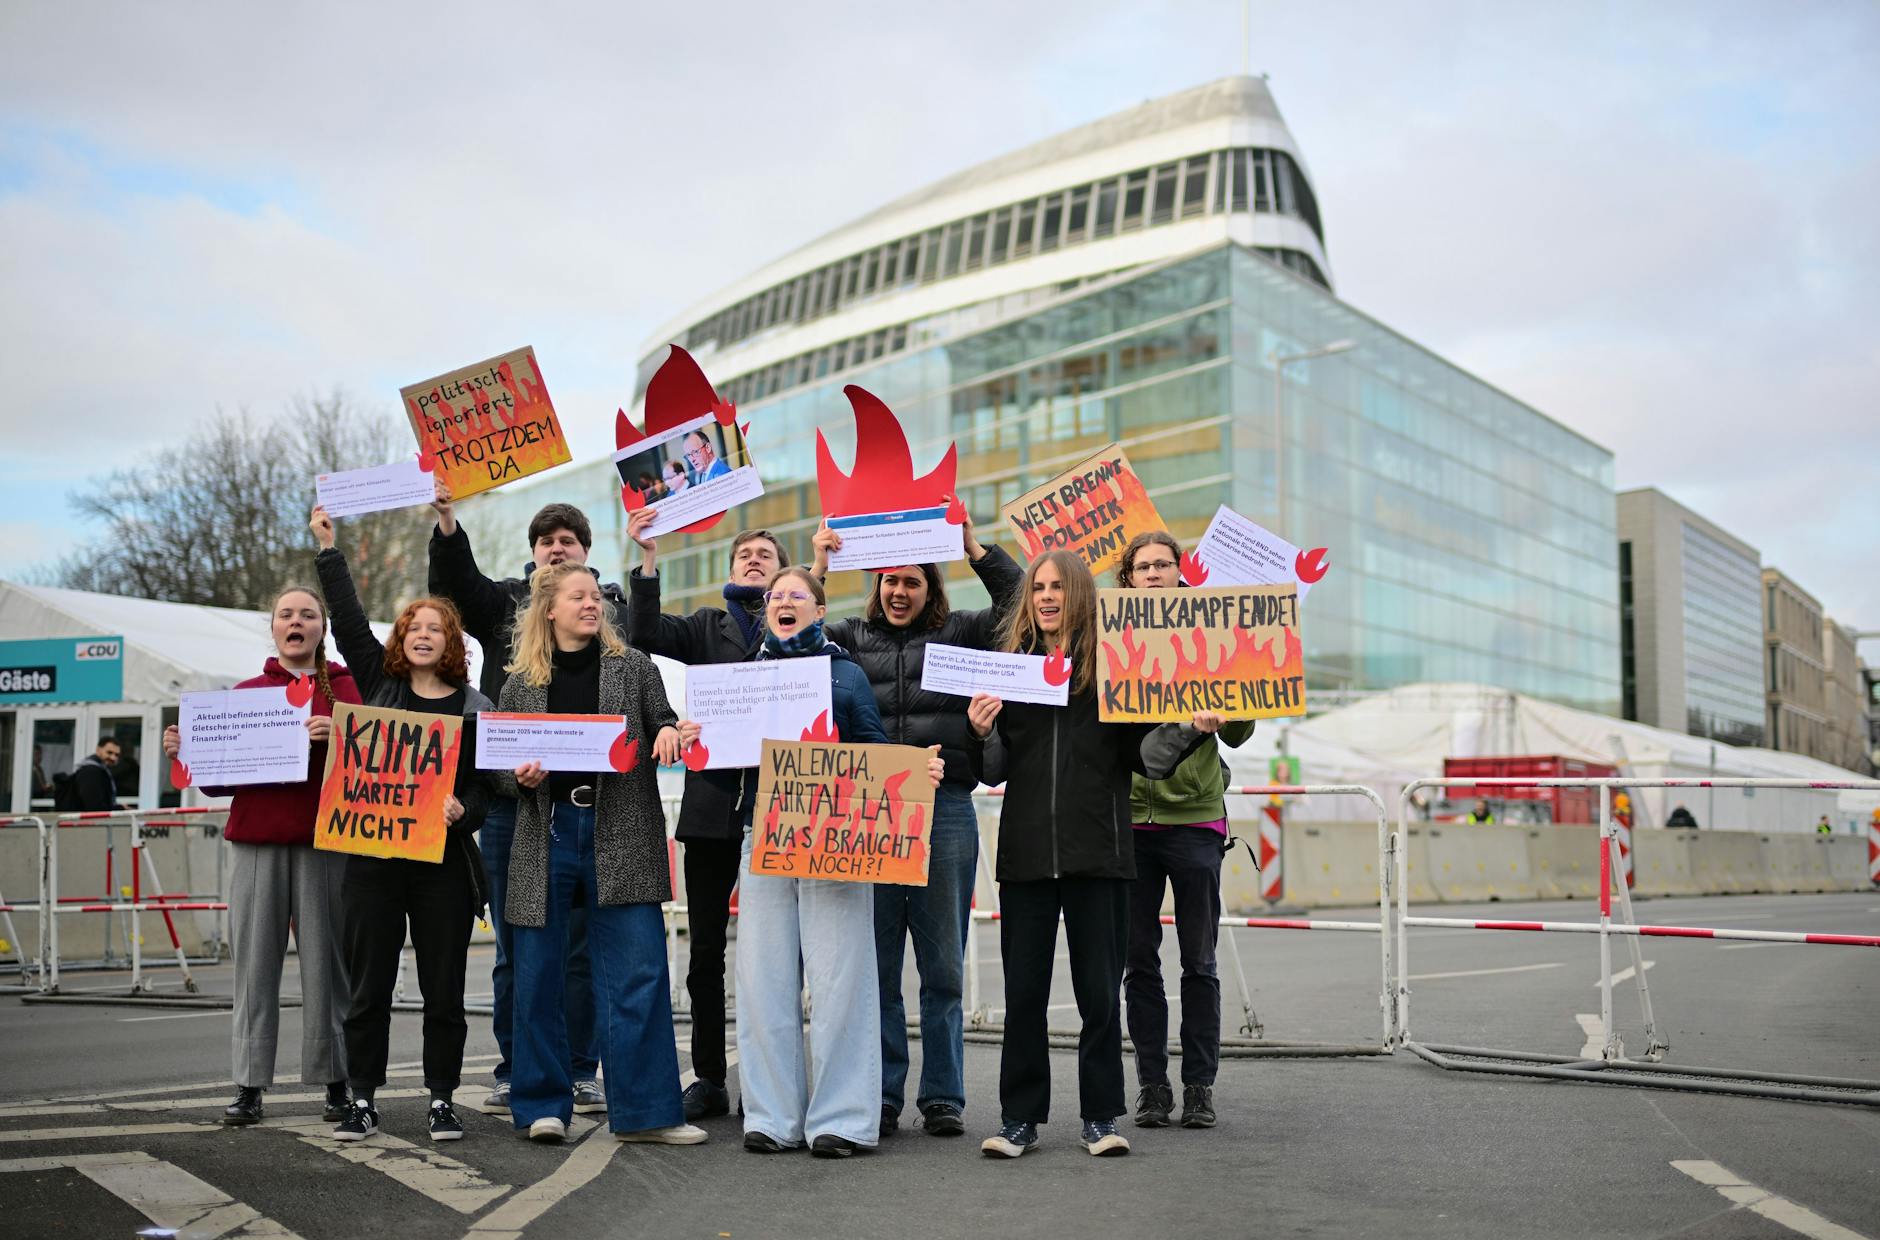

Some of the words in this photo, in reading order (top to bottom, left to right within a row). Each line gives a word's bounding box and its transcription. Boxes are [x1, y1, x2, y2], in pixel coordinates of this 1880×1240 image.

[418, 369, 506, 418] politisch
[426, 392, 514, 443] ignoriert
[435, 416, 556, 470] TROTZDEM
[487, 455, 521, 480] DA
[1010, 492, 1059, 532] WELT
[1060, 458, 1121, 507] BRENNT
[1042, 498, 1124, 551] POLITIK
[1218, 520, 1245, 538] Forscher
[1244, 536, 1256, 545] und
[1256, 541, 1269, 552] BND
[1268, 548, 1286, 562] sehen
[1211, 534, 1242, 555] Klimakrise
[1241, 552, 1264, 568] bedroht
[1214, 528, 1241, 546] nationale
[1240, 542, 1270, 563] Sicherheit
[1269, 557, 1287, 572] durch
[1100, 596, 1234, 633] WAHLKAMPF
[1239, 594, 1297, 629] ENDET
[87, 645, 117, 657] CDU
[929, 653, 947, 661] Feuer
[995, 662, 1026, 670] teuersten
[0, 669, 51, 692] Gäste
[928, 661, 988, 675] Naturkatastrophen
[693, 687, 723, 697] Umwelt
[725, 686, 740, 695] und
[743, 682, 793, 694] Klimawandel
[794, 681, 810, 689] laut
[693, 698, 728, 708] Umfrage
[729, 695, 766, 706] wichtiger
[767, 693, 779, 702] als
[780, 691, 818, 702] Migration
[1104, 679, 1237, 714] KLIMAKRISE
[1240, 677, 1303, 711] NICHT
[192, 723, 230, 732] Gletscher
[232, 722, 240, 730] in
[241, 721, 260, 729] einer
[262, 719, 301, 728] schweren
[229, 710, 262, 719] befinden
[264, 709, 280, 717] sich
[282, 708, 294, 716] die
[693, 709, 709, 718] und
[711, 706, 752, 716] Wirtschaft
[344, 712, 443, 775] KLIMA
[498, 727, 516, 735] Januar
[543, 728, 553, 736] der
[773, 748, 874, 782] VALENCIA,
[344, 776, 420, 806] WARTET
[769, 780, 852, 822] AHRTAL,
[862, 788, 893, 824] LA
[328, 808, 417, 841] NICHT
[766, 822, 813, 848] WAS
[824, 827, 920, 859] BRAUCHT
[762, 852, 796, 871] ES
[809, 854, 884, 876] NOCH?!
